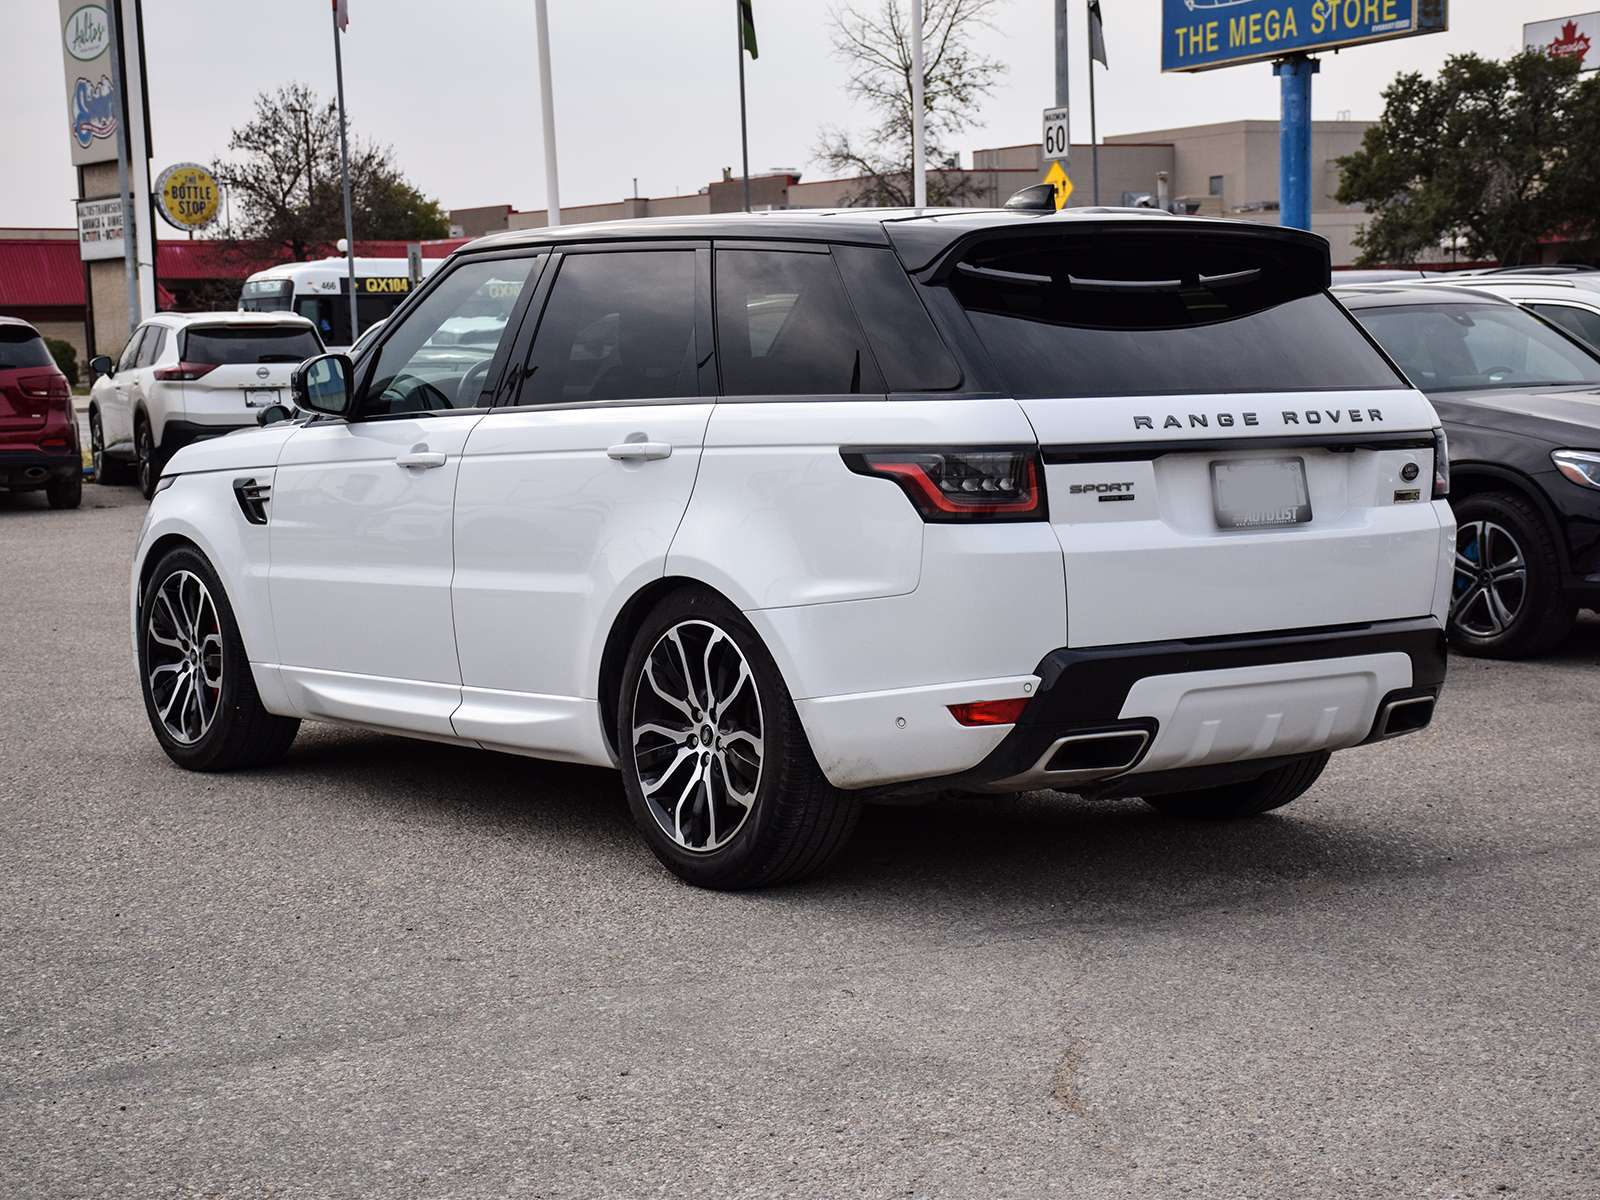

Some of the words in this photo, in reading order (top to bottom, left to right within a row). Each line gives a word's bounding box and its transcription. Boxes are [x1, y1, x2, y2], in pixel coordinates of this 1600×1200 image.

[1175, 21, 1219, 57] THE
[1229, 7, 1298, 47] MEGA
[1312, 0, 1398, 34] STORE
[1046, 125, 1065, 153] 60
[171, 185, 211, 200] BOTTLE
[178, 200, 206, 215] STOP
[321, 281, 336, 290] 466
[366, 277, 408, 292] QX104
[1133, 412, 1259, 429] RANGE
[1282, 408, 1384, 425] ROVER
[1070, 482, 1134, 494] SPORT
